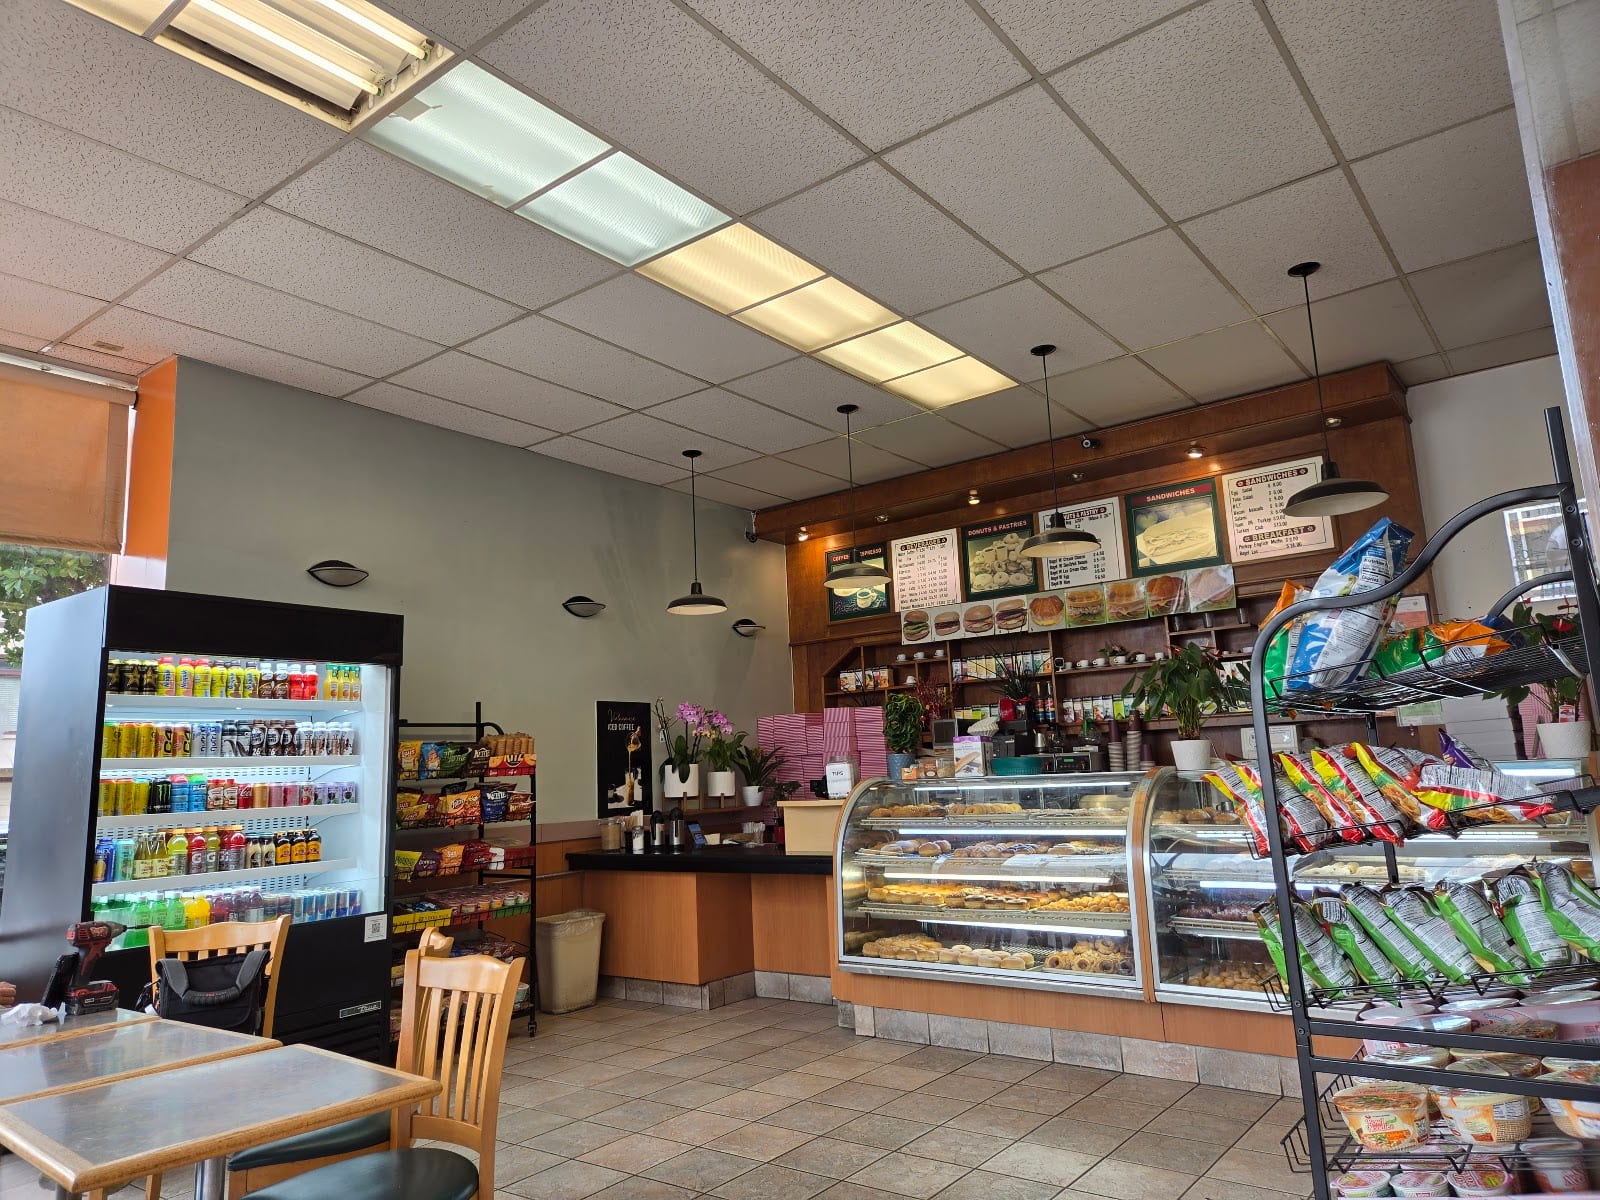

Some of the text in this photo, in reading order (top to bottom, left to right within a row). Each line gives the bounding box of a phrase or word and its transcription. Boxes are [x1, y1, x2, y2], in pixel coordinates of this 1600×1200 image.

[1245, 470, 1298, 484] SANDWICHES
[1146, 487, 1195, 502] SANDWICHES
[968, 527, 991, 536] DONUTS
[998, 520, 1027, 530] PASTRIES
[1252, 526, 1305, 541] BREAKFAST
